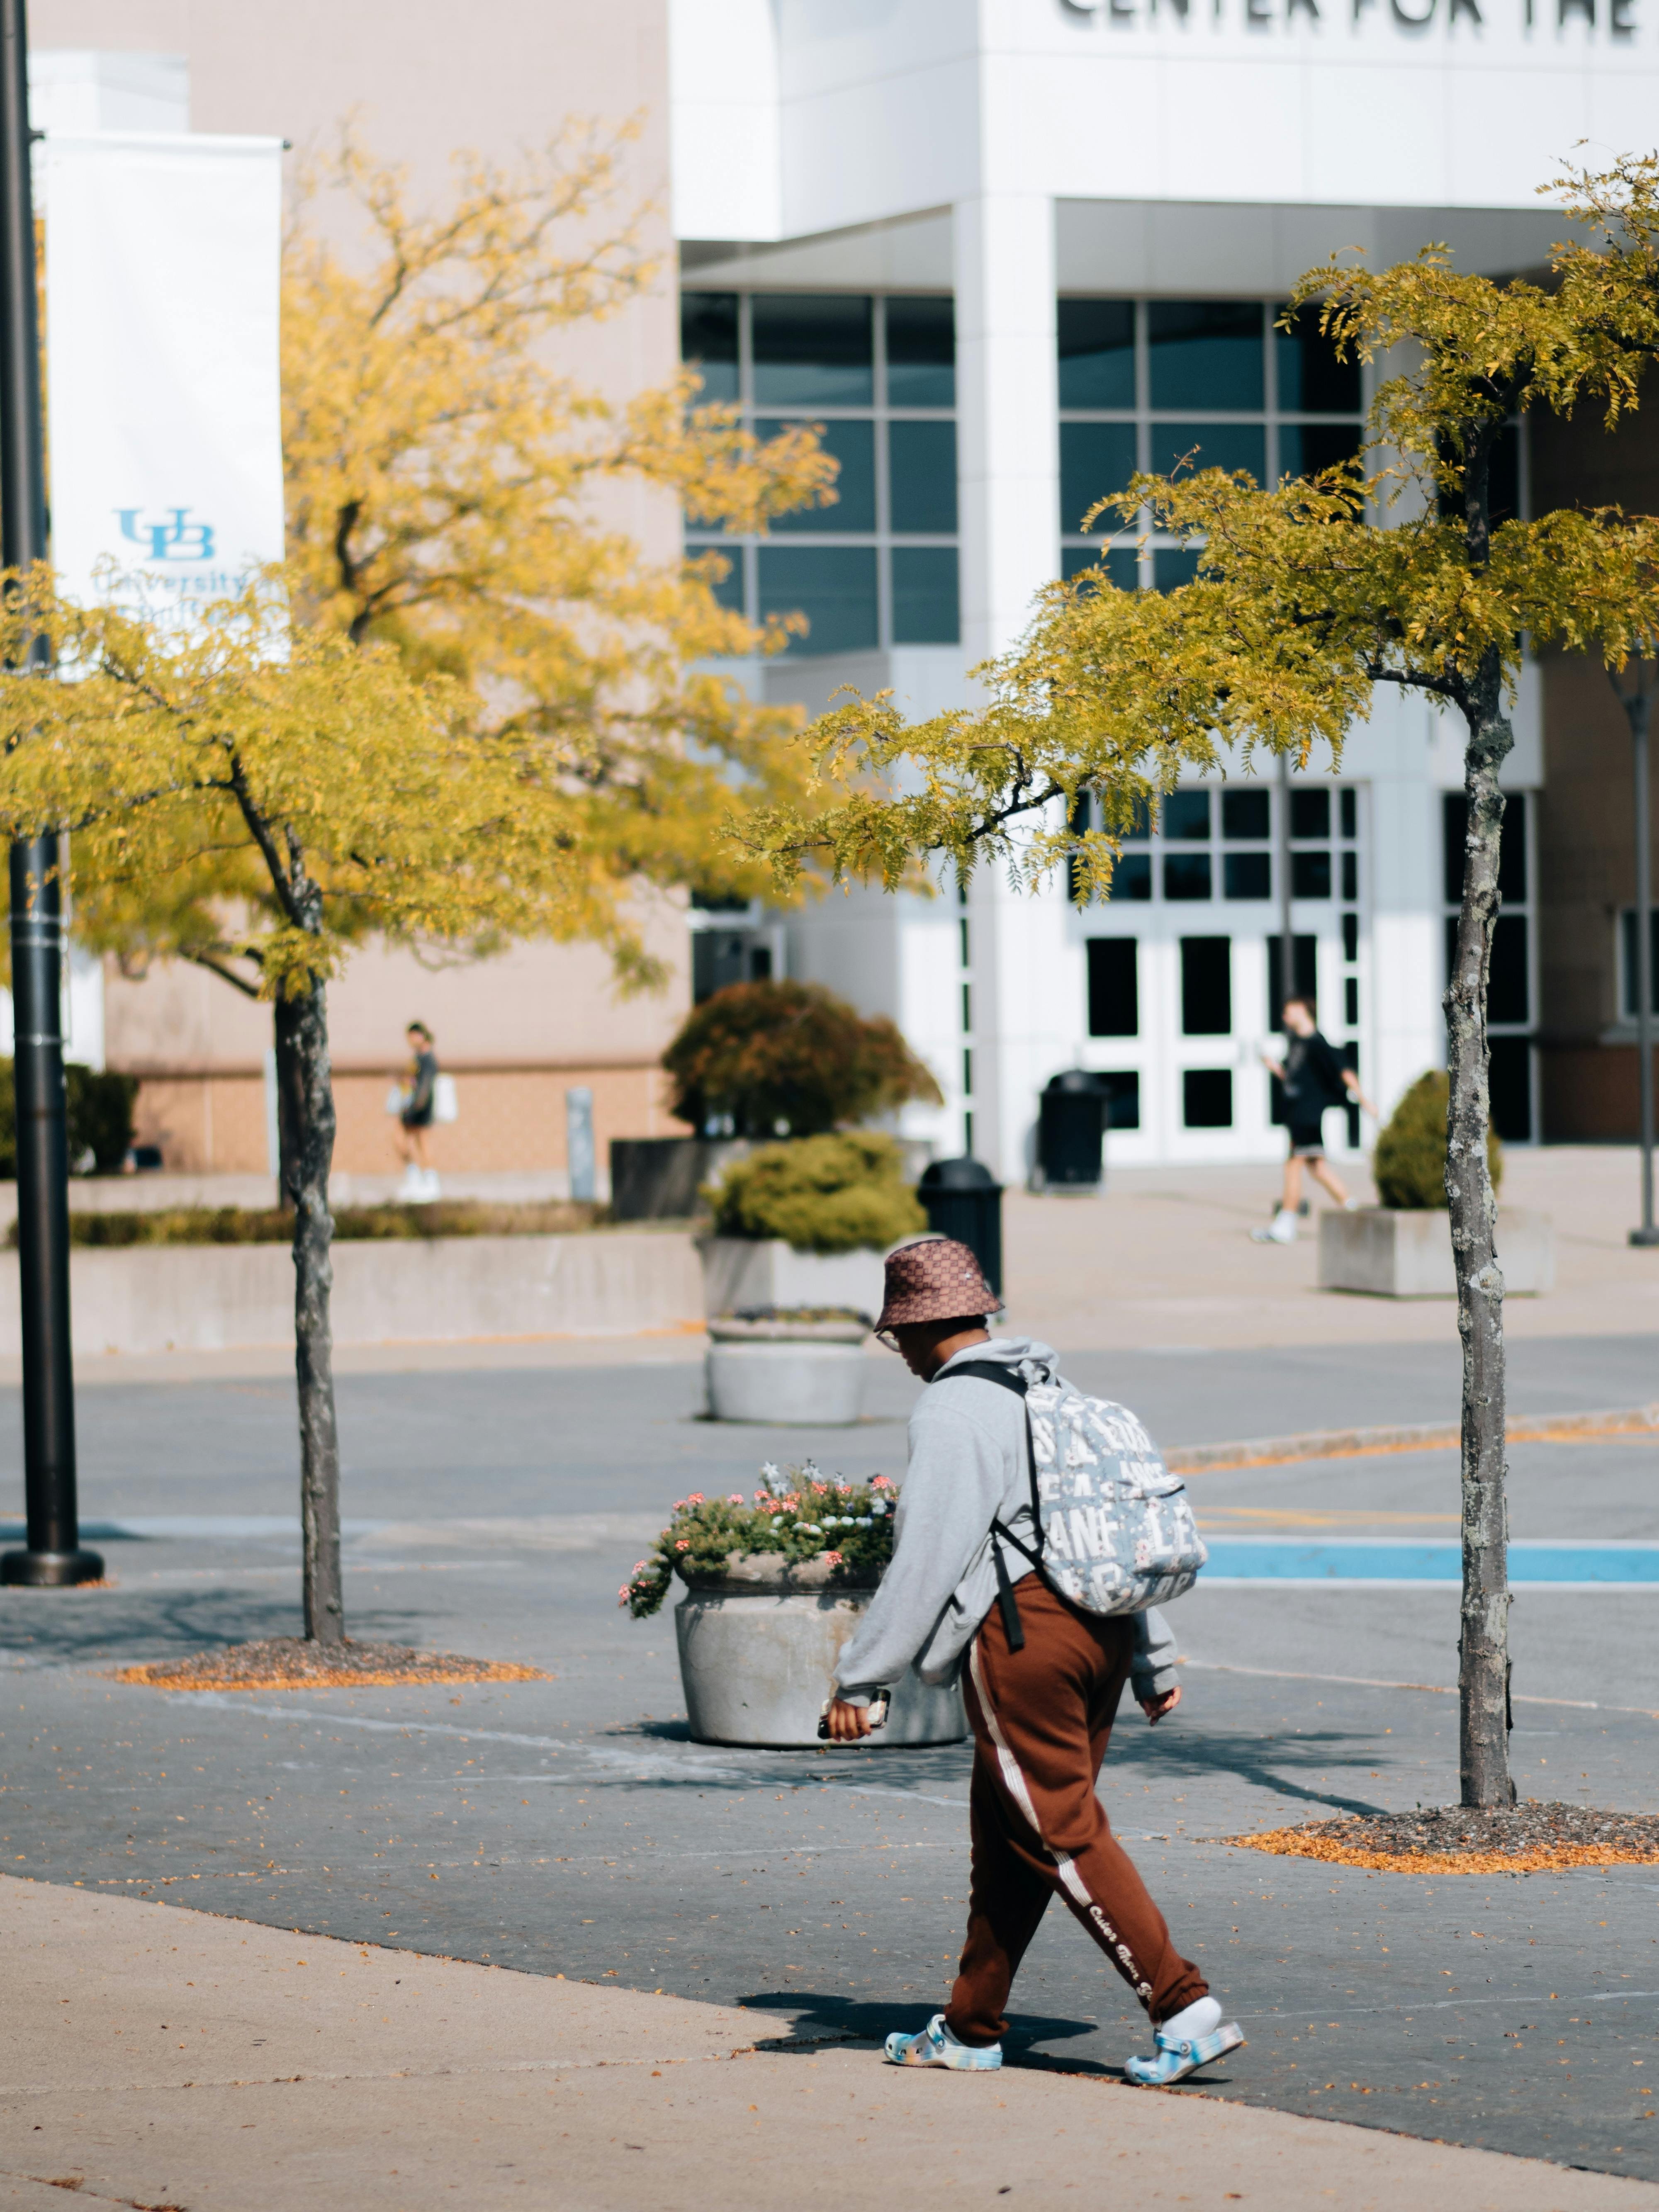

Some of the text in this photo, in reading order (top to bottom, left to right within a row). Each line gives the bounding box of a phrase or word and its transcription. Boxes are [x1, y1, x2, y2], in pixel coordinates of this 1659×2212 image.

[111, 507, 216, 561] UB
[1090, 1906, 1117, 1942] Cuter
[1116, 1944, 1139, 1981] Than
